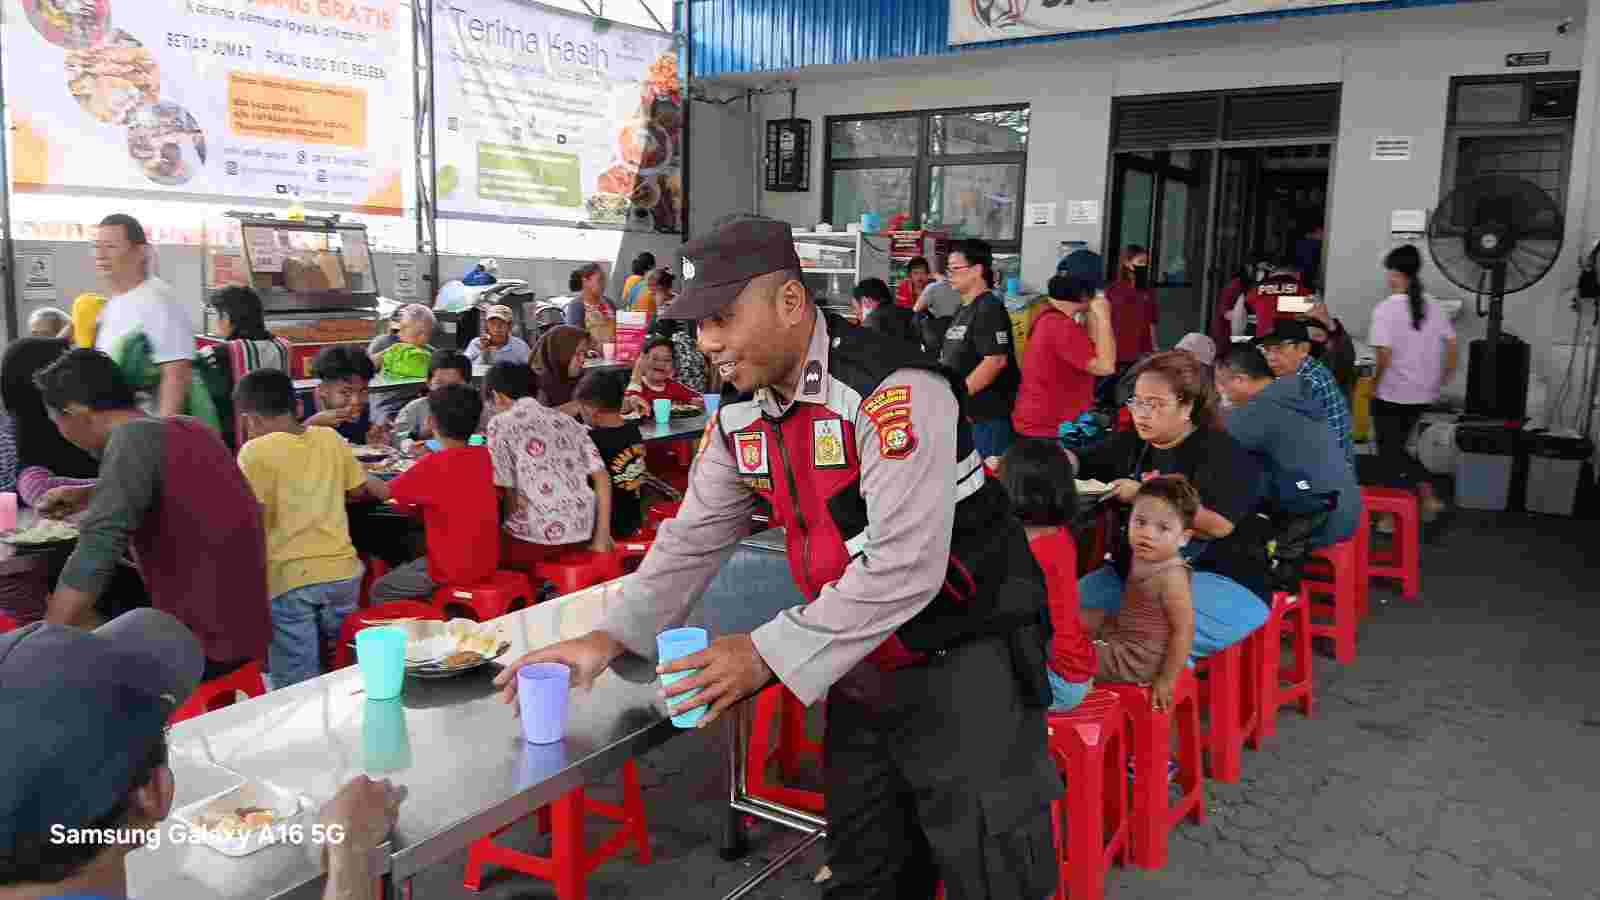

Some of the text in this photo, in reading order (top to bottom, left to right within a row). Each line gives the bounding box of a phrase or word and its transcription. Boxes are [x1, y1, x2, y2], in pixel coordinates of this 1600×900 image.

[167, 31, 209, 49] SETIAP
[213, 40, 254, 61] JUMAT
[447, 6, 538, 54] Terima
[547, 30, 609, 69] Kasih
[1257, 284, 1297, 295] POLISI
